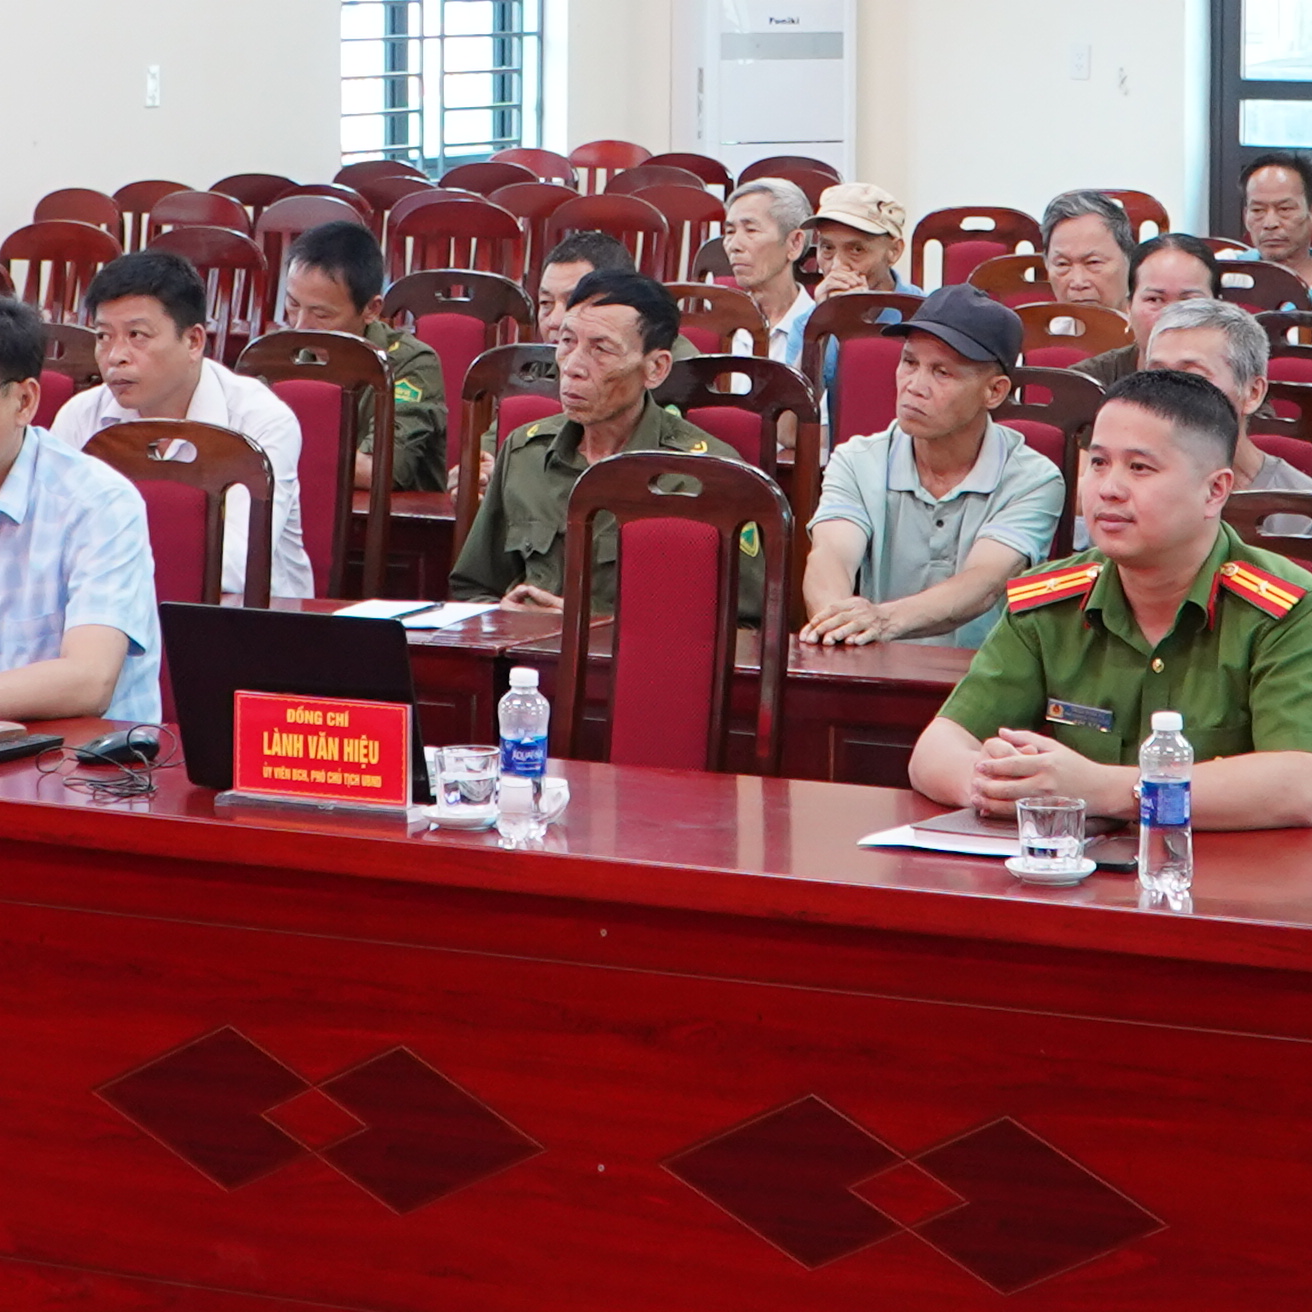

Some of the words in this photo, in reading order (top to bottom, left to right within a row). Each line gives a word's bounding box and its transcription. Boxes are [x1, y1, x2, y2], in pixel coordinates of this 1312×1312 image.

[326, 710, 350, 728] CHÍ
[262, 727, 304, 758] LÀNH
[307, 731, 339, 762] VĂN
[343, 735, 379, 769] HIỆU
